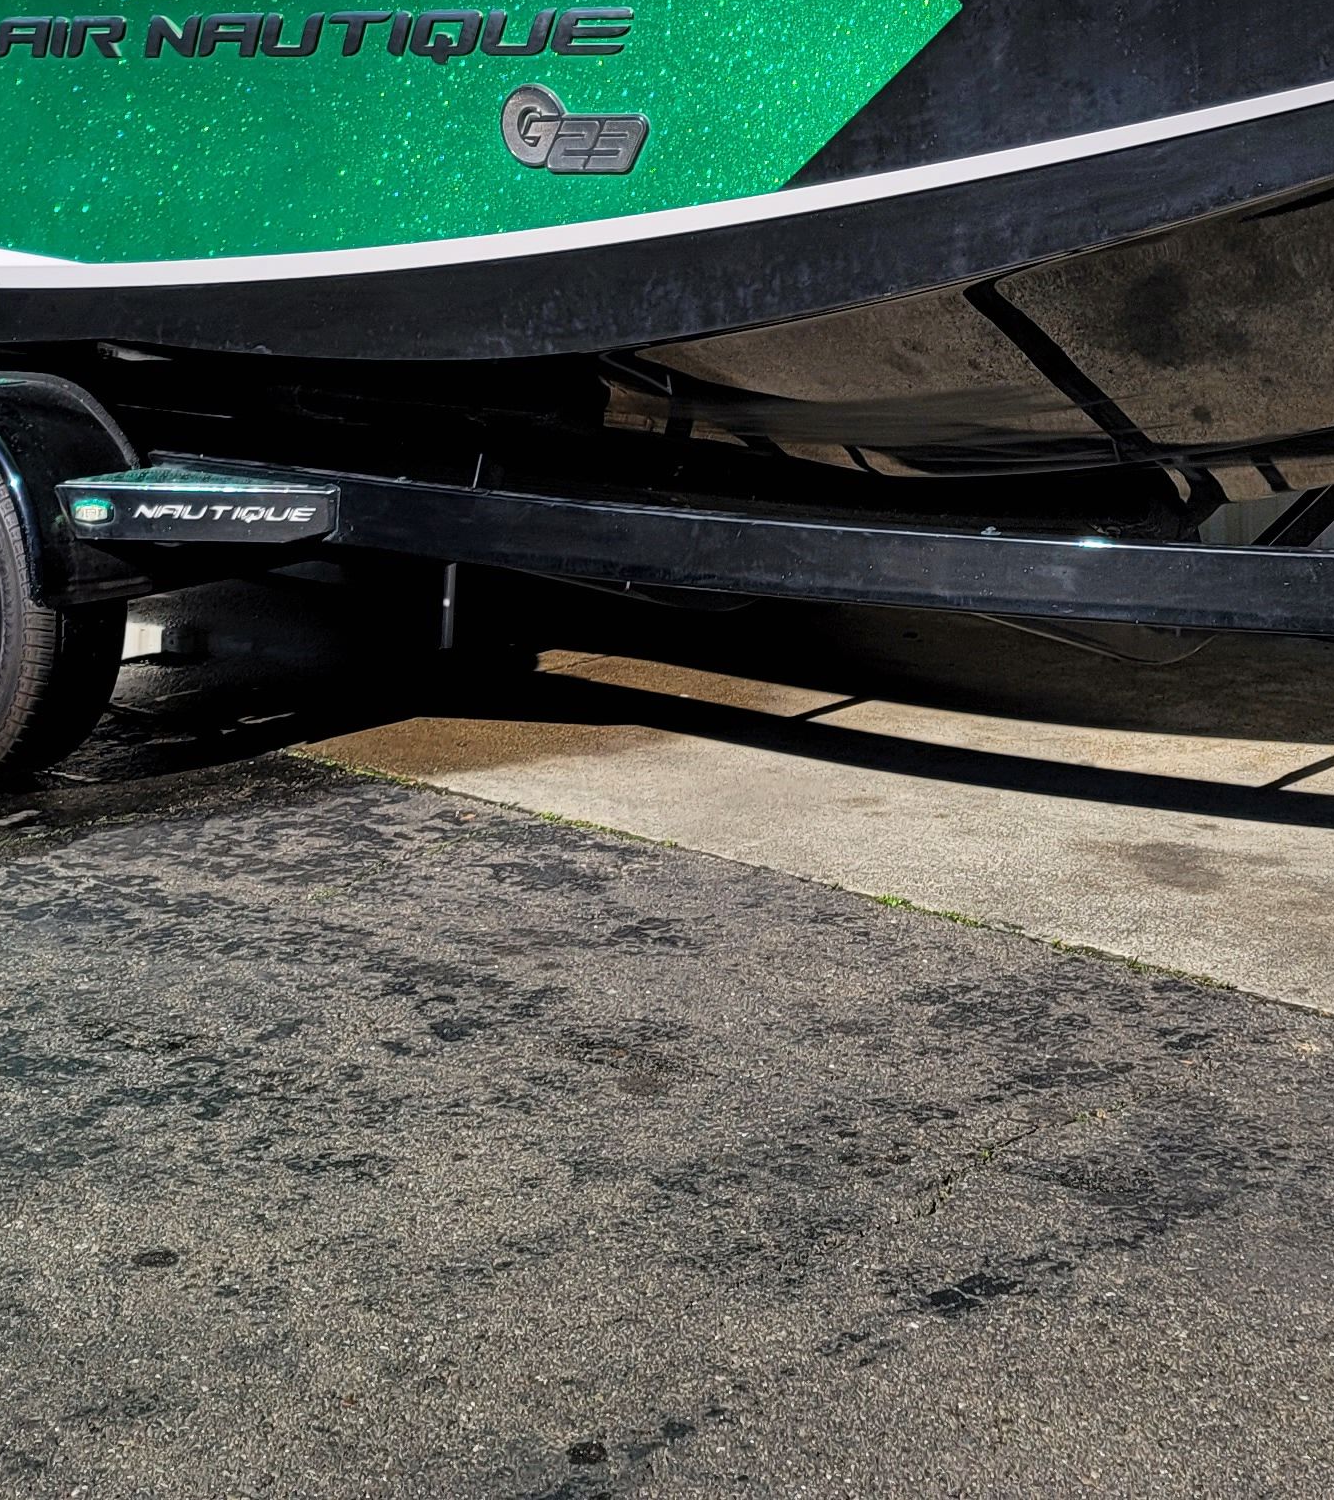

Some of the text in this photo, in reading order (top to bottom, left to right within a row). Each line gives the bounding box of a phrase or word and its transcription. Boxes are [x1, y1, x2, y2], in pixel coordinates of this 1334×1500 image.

[144, 7, 634, 65] NAUTIQUE
[501, 84, 648, 172] G23
[132, 504, 317, 523] NAUTIQUE
